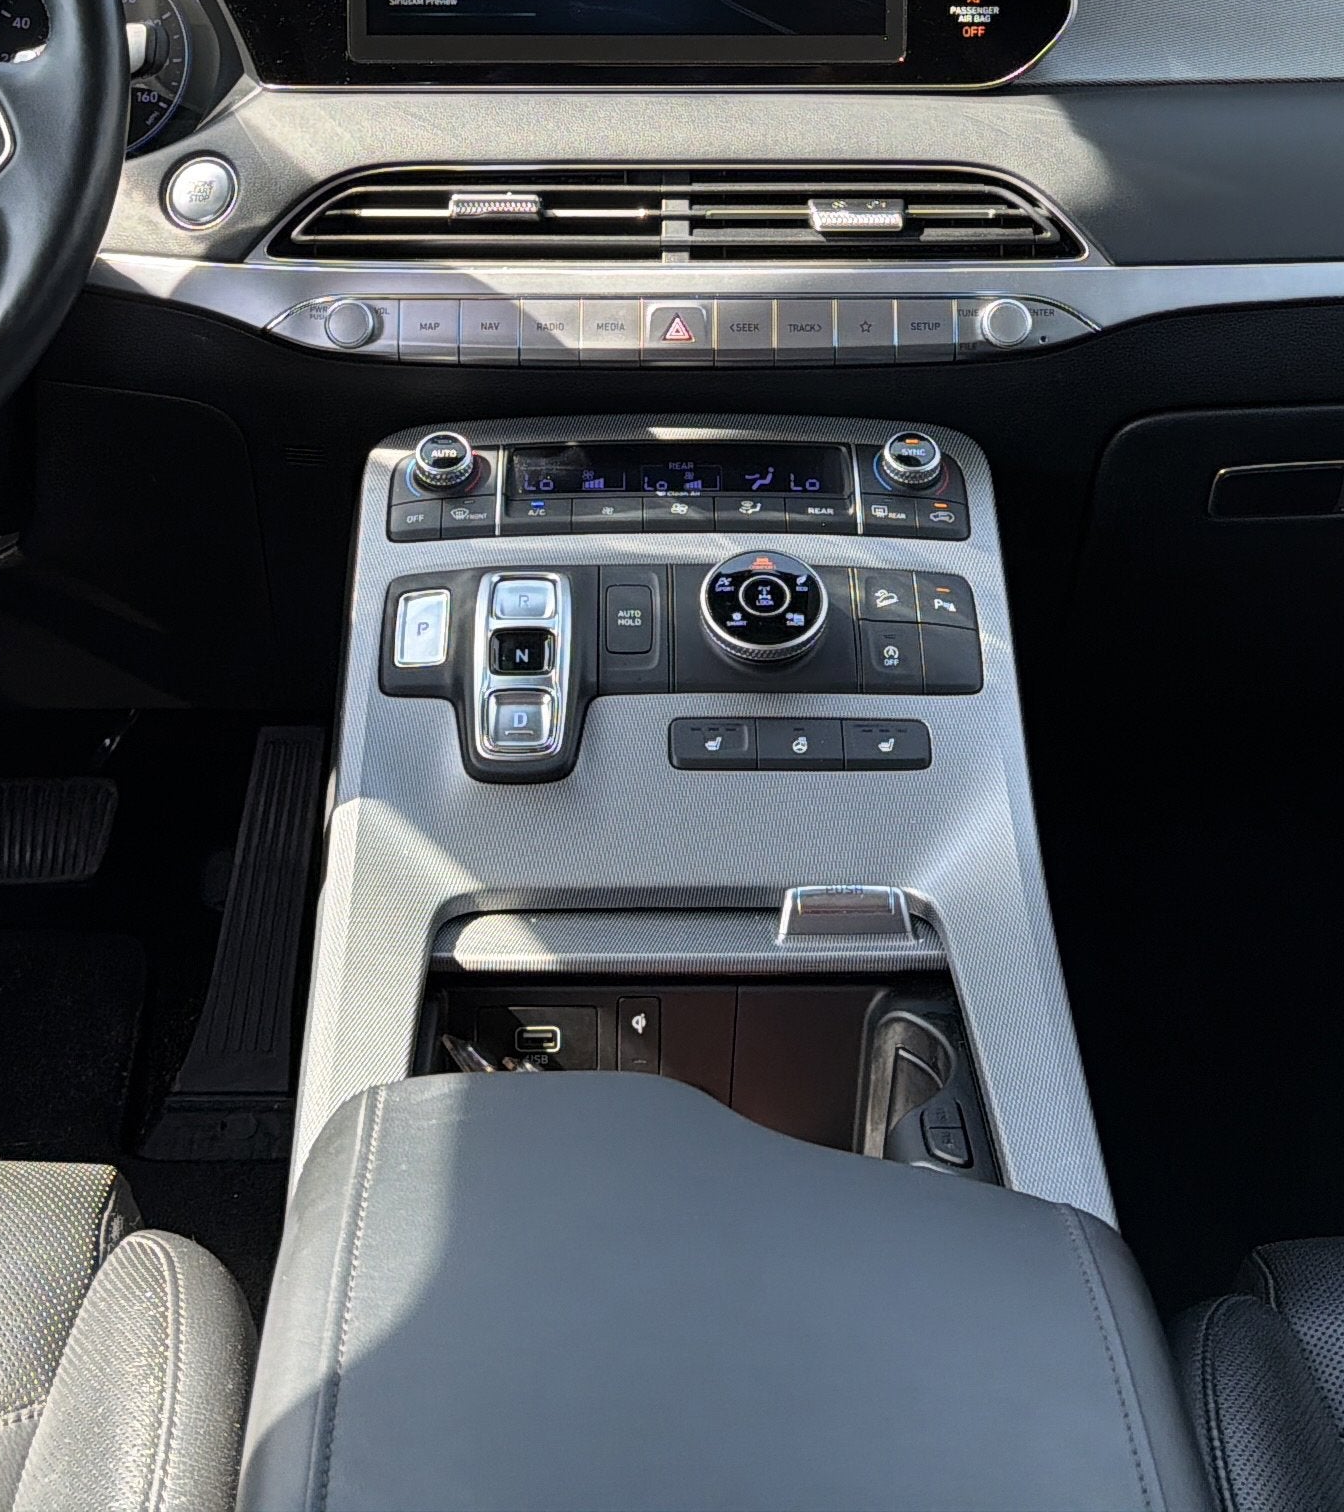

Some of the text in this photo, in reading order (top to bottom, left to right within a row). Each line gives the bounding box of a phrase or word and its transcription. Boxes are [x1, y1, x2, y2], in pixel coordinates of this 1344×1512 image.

[949, 6, 1000, 15] PASSENGER
[12, 17, 31, 30] 40
[973, 15, 991, 23] BAG
[962, 26, 986, 37] OFF
[136, 91, 159, 104] 160
[419, 322, 441, 331] MAP
[480, 322, 501, 331] NAV
[536, 322, 565, 332] RADIO
[596, 322, 626, 332] MEDIA
[910, 322, 942, 332] SETUP
[431, 449, 457, 457] AUTO
[901, 448, 927, 457] SYNC
[528, 508, 547, 516] A/C
[808, 506, 835, 515] REAR
[406, 514, 425, 524] OFF
[519, 594, 531, 609] R
[617, 609, 642, 617] AUTO
[617, 618, 642, 626] HOLD
[417, 621, 429, 636] P
[515, 648, 529, 663] N
[513, 712, 528, 728] D
